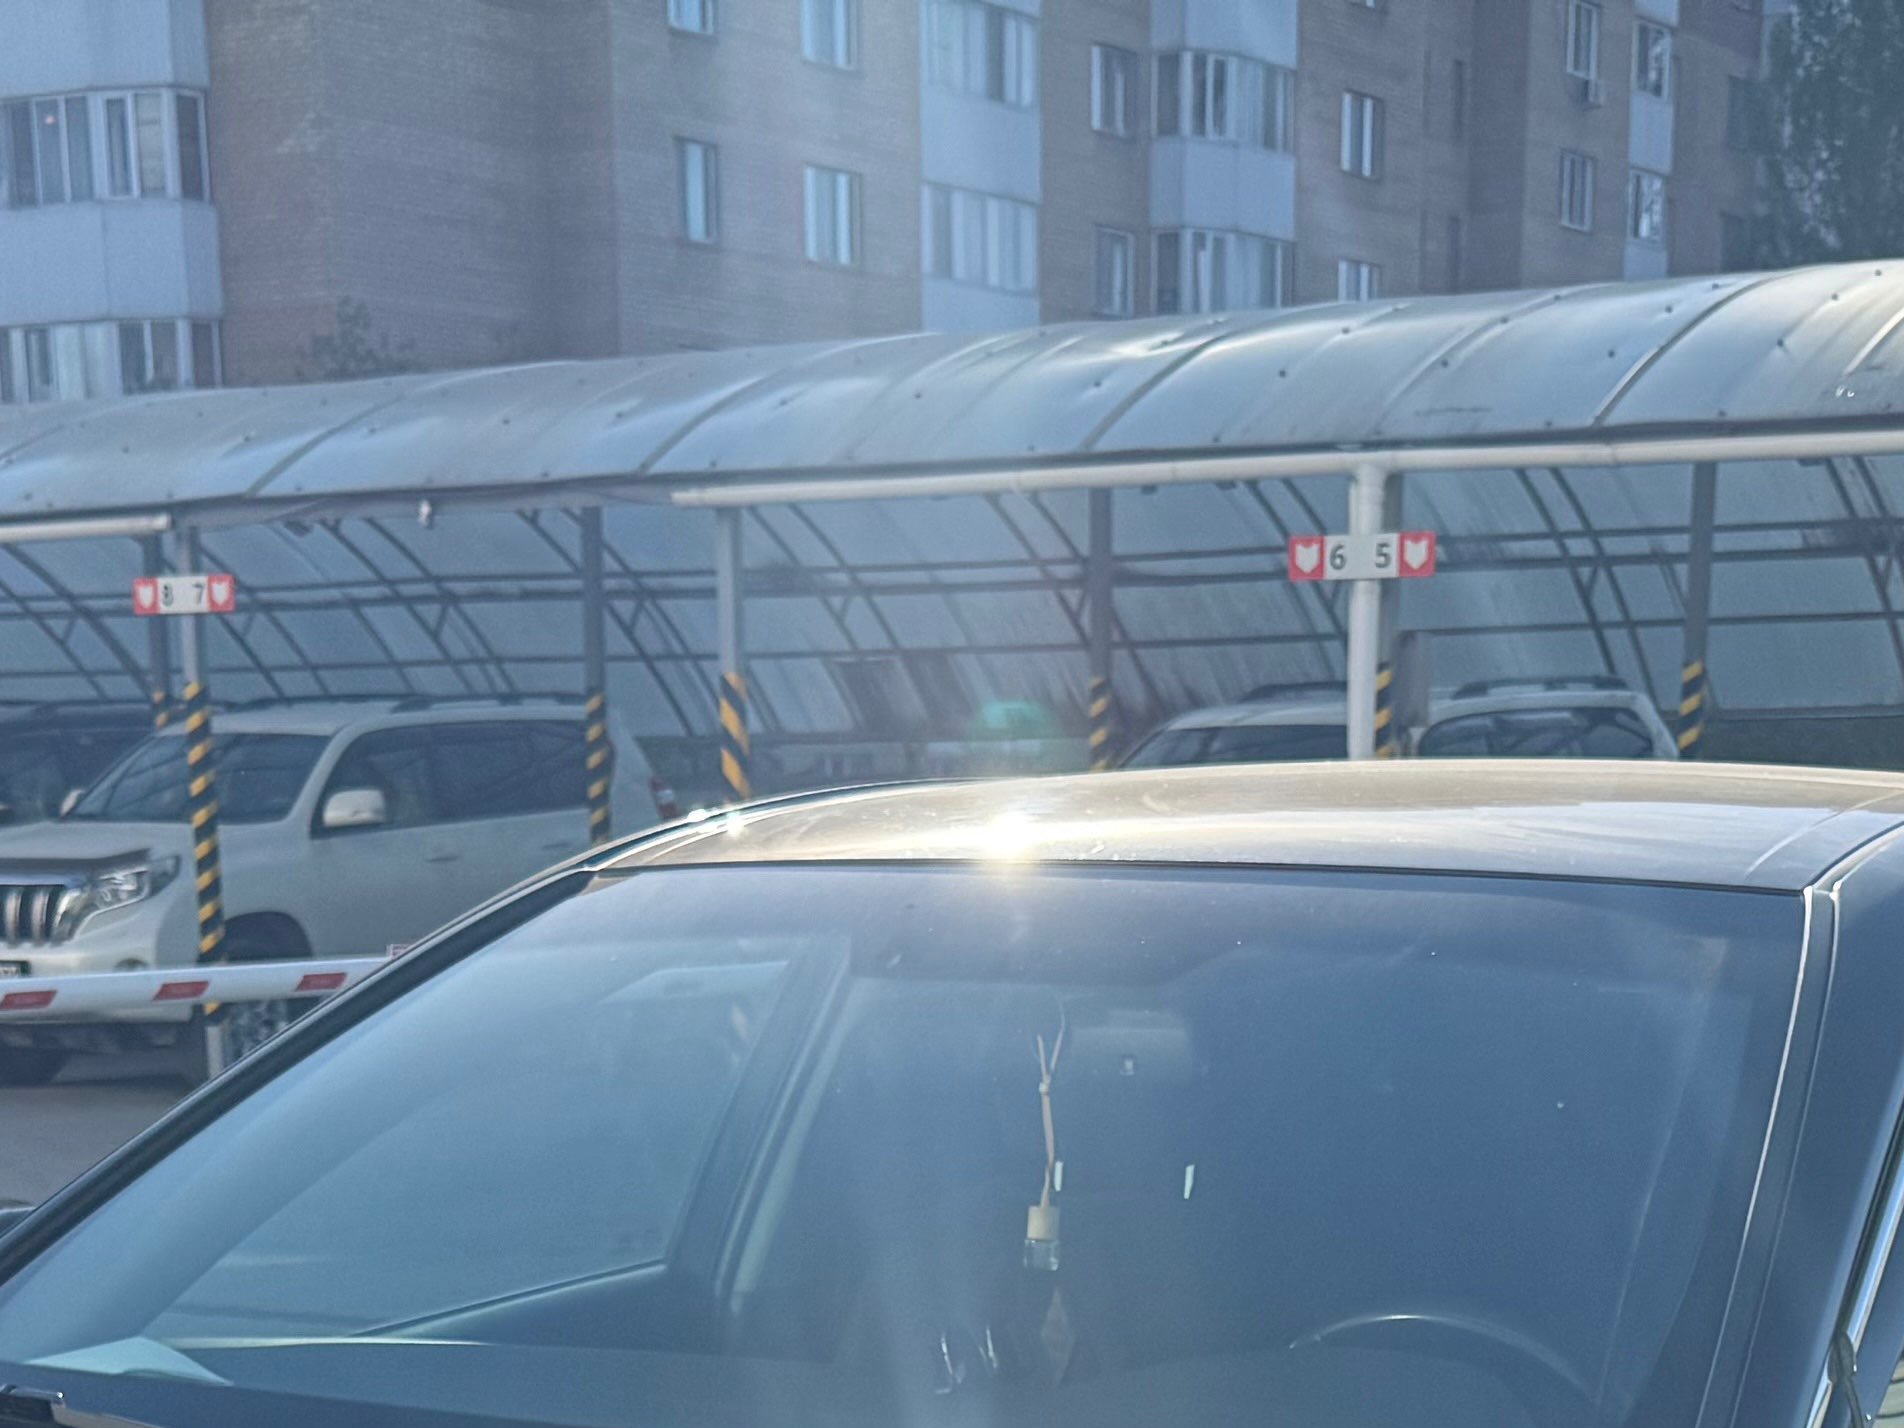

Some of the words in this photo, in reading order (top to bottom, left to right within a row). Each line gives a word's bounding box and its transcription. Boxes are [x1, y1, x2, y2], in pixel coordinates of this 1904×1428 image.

[1329, 544, 1346, 570] 6
[1375, 542, 1391, 569] 5
[161, 583, 174, 608] 8
[192, 583, 205, 605] 7
